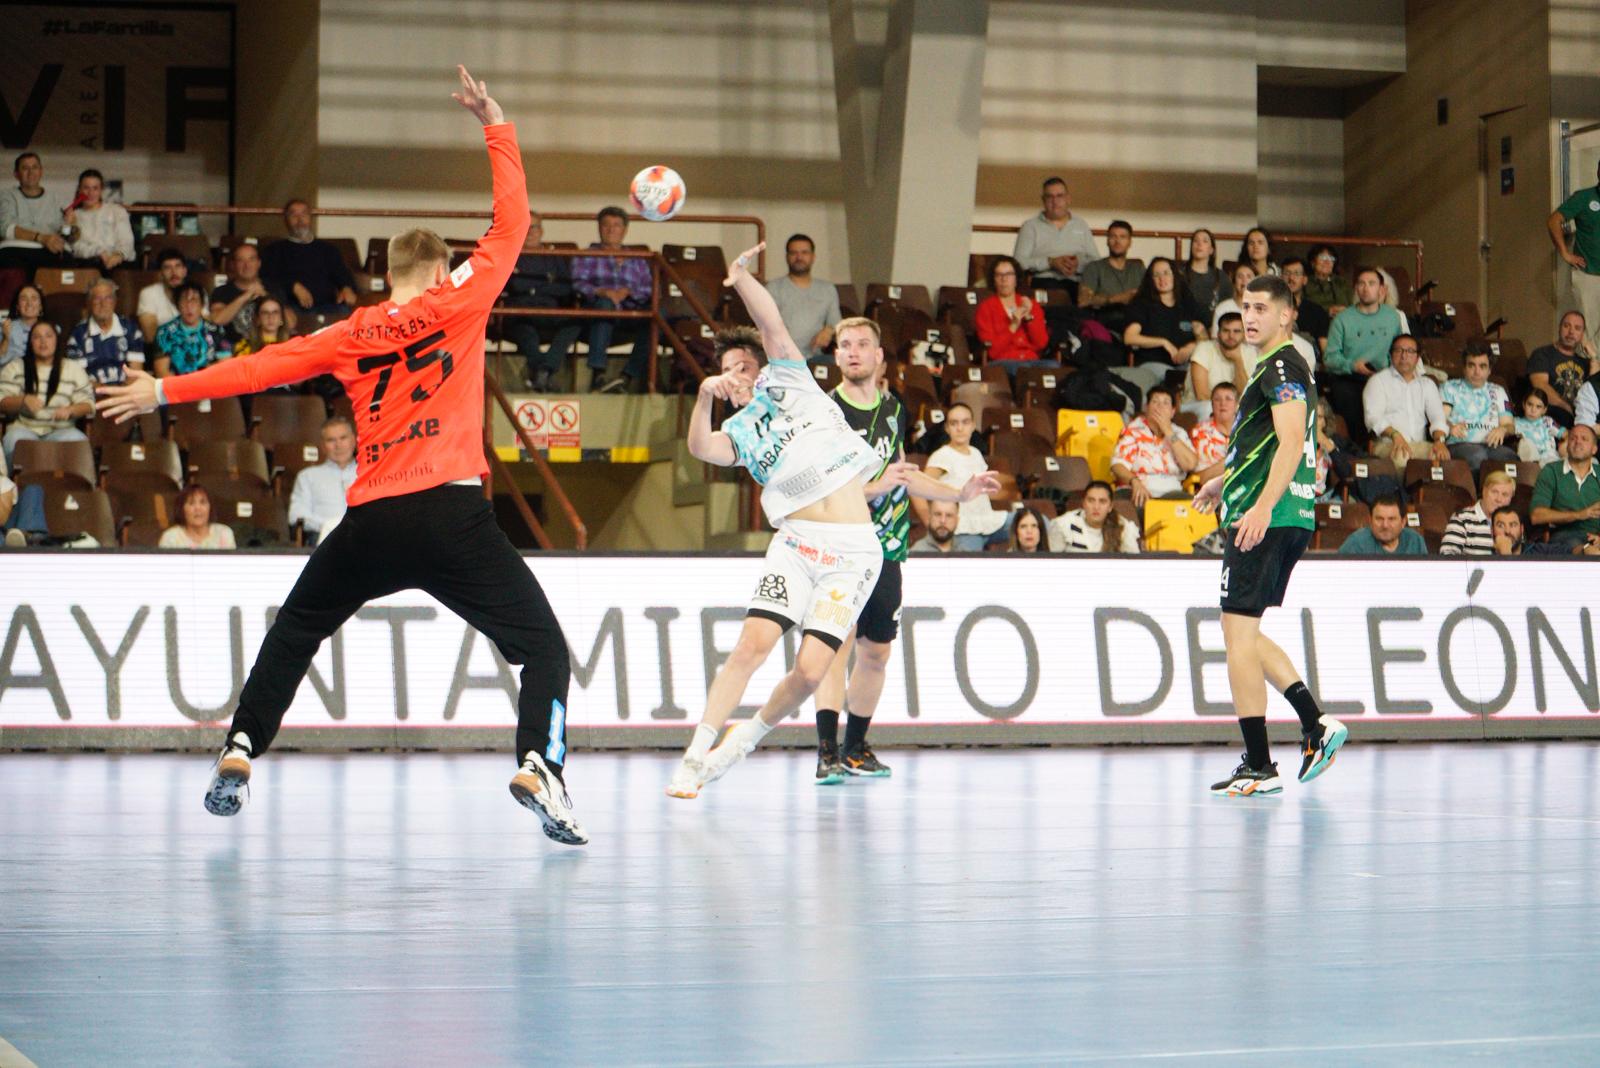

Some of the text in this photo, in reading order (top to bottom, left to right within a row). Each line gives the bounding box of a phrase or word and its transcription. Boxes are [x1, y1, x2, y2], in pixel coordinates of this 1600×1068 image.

[42, 19, 175, 36] #LaFamilia
[80, 64, 99, 151] AREA
[357, 329, 455, 422] 75
[754, 412, 773, 438] 17
[1300, 568, 1600, 716] LEÓN
